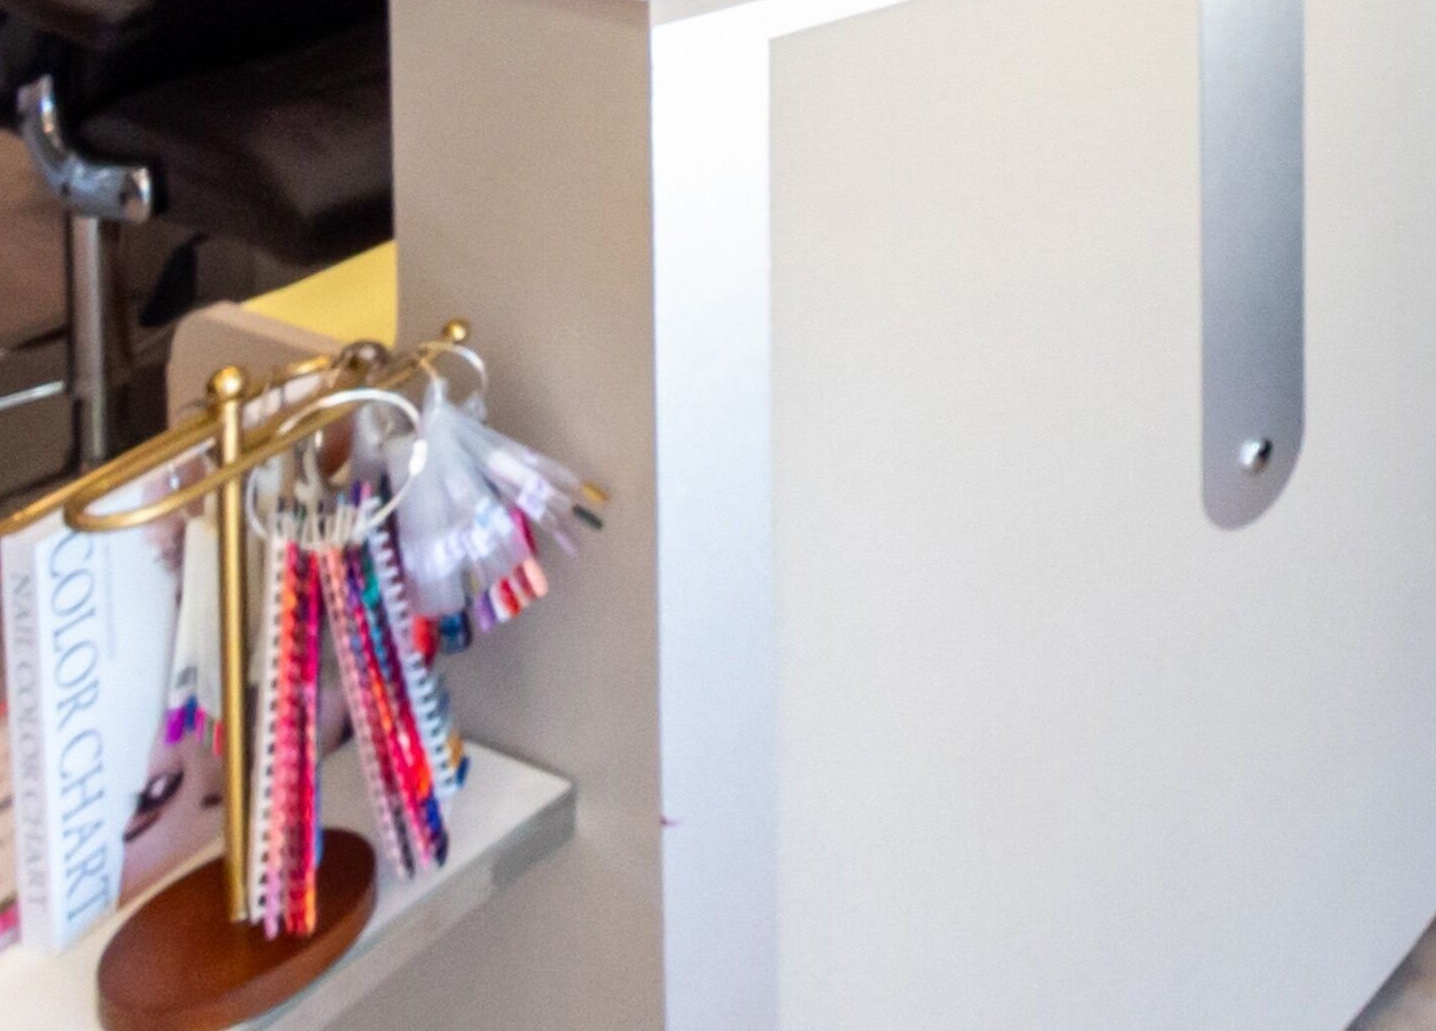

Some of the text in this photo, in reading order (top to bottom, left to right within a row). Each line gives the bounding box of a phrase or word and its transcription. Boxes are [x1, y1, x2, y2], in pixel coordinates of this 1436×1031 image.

[16, 660, 41, 781] COLOR
[48, 529, 110, 924] COLOR CHART
